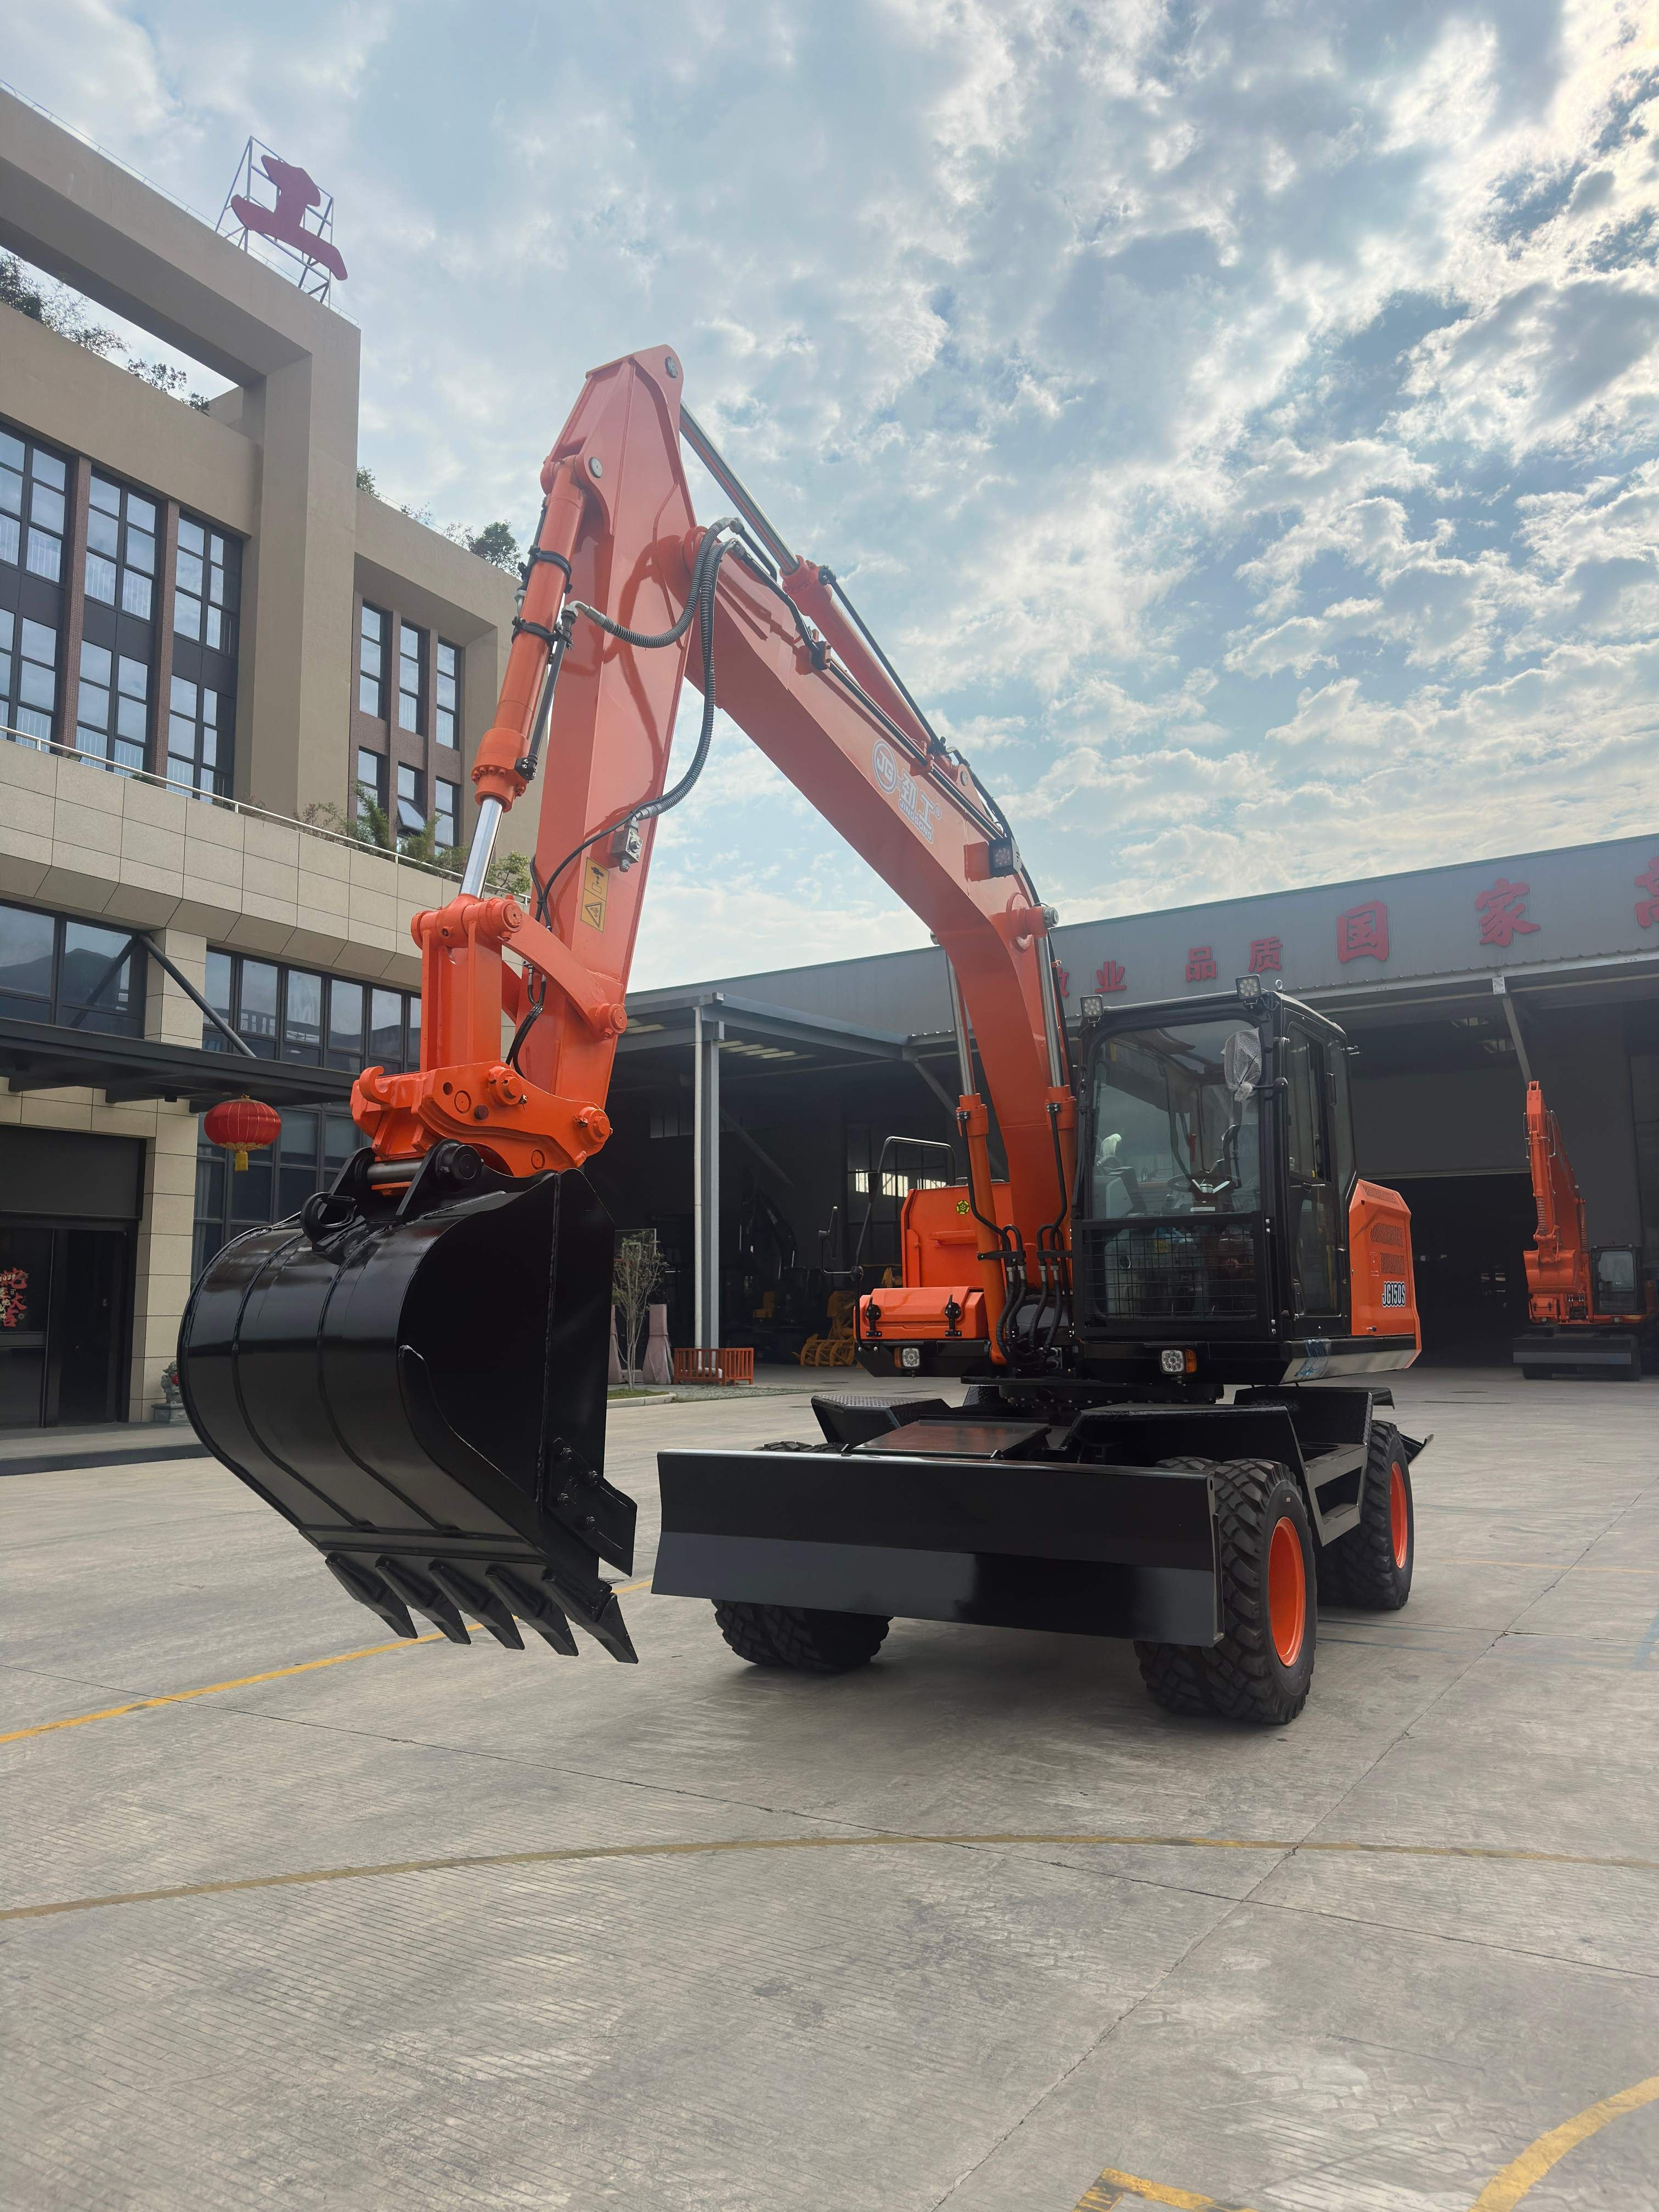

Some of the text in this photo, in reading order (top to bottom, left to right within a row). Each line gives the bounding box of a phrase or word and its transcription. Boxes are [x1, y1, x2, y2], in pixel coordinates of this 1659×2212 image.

[900, 801, 933, 840] JINGGONG
[901, 771, 934, 830] 劲工
[1186, 936, 1283, 983] 品质
[1382, 1282, 1406, 1307] JG150S
